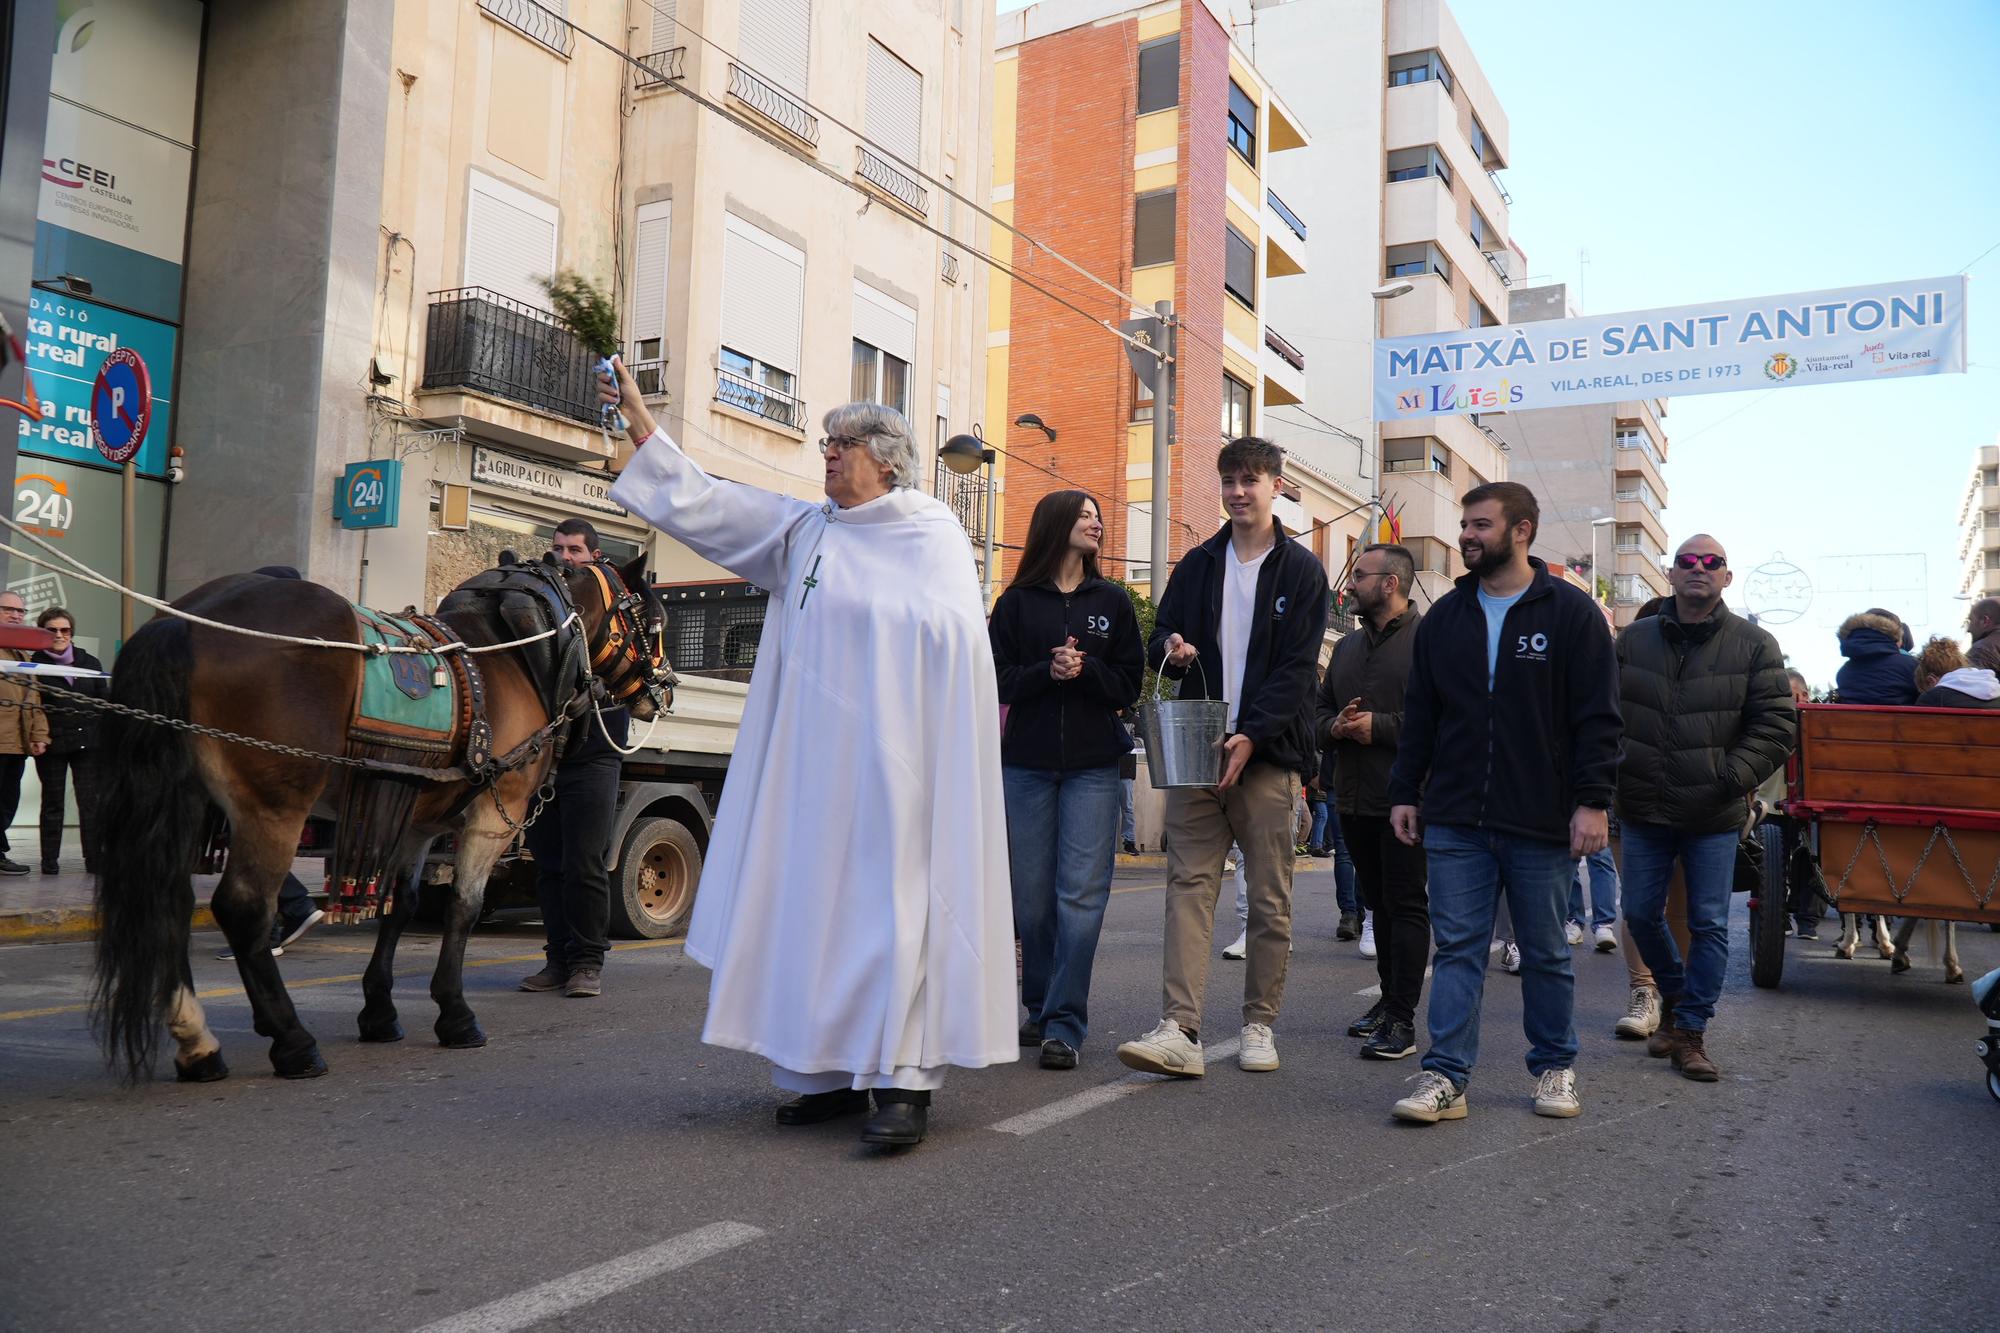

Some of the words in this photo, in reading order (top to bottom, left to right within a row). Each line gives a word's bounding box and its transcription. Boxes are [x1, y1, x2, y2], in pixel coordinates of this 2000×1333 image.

[60, 158, 115, 189] CEEI
[89, 202, 122, 219] EUROPEOS
[1389, 329, 1536, 377] MATXÀ
[1549, 338, 1588, 362] DE
[1602, 315, 1729, 356] SANT
[1738, 293, 1943, 343] ANTONI
[101, 351, 136, 376] EXCEPTO
[1807, 360, 1853, 372] Vila-real
[1888, 350, 1931, 361] Vila-real
[1551, 374, 1638, 392] VILA-REAL,
[1642, 370, 1673, 384] DES
[1679, 367, 1701, 381] DE
[1707, 364, 1742, 379] 1973
[488, 459, 563, 489] AGRUPACION
[1087, 615, 1110, 631] 50
[1516, 632, 1548, 653] 50
